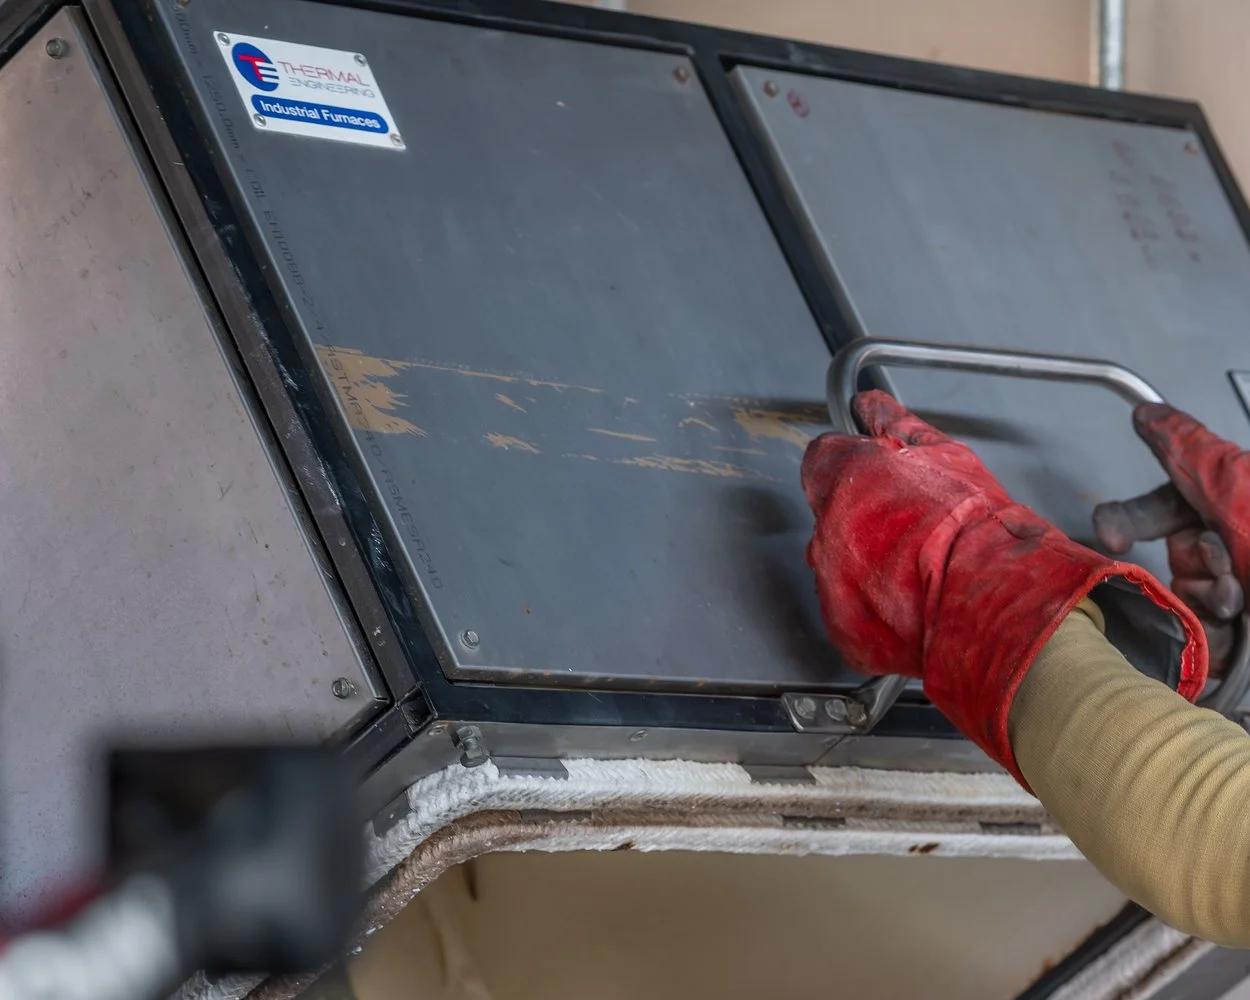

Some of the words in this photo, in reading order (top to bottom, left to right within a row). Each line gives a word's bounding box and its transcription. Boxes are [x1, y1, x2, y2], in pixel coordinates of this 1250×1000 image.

[277, 61, 370, 87] THERMAL
[289, 77, 375, 98] ENGINEERING
[260, 100, 320, 120] Industrial
[321, 109, 380, 129] Furnaces
